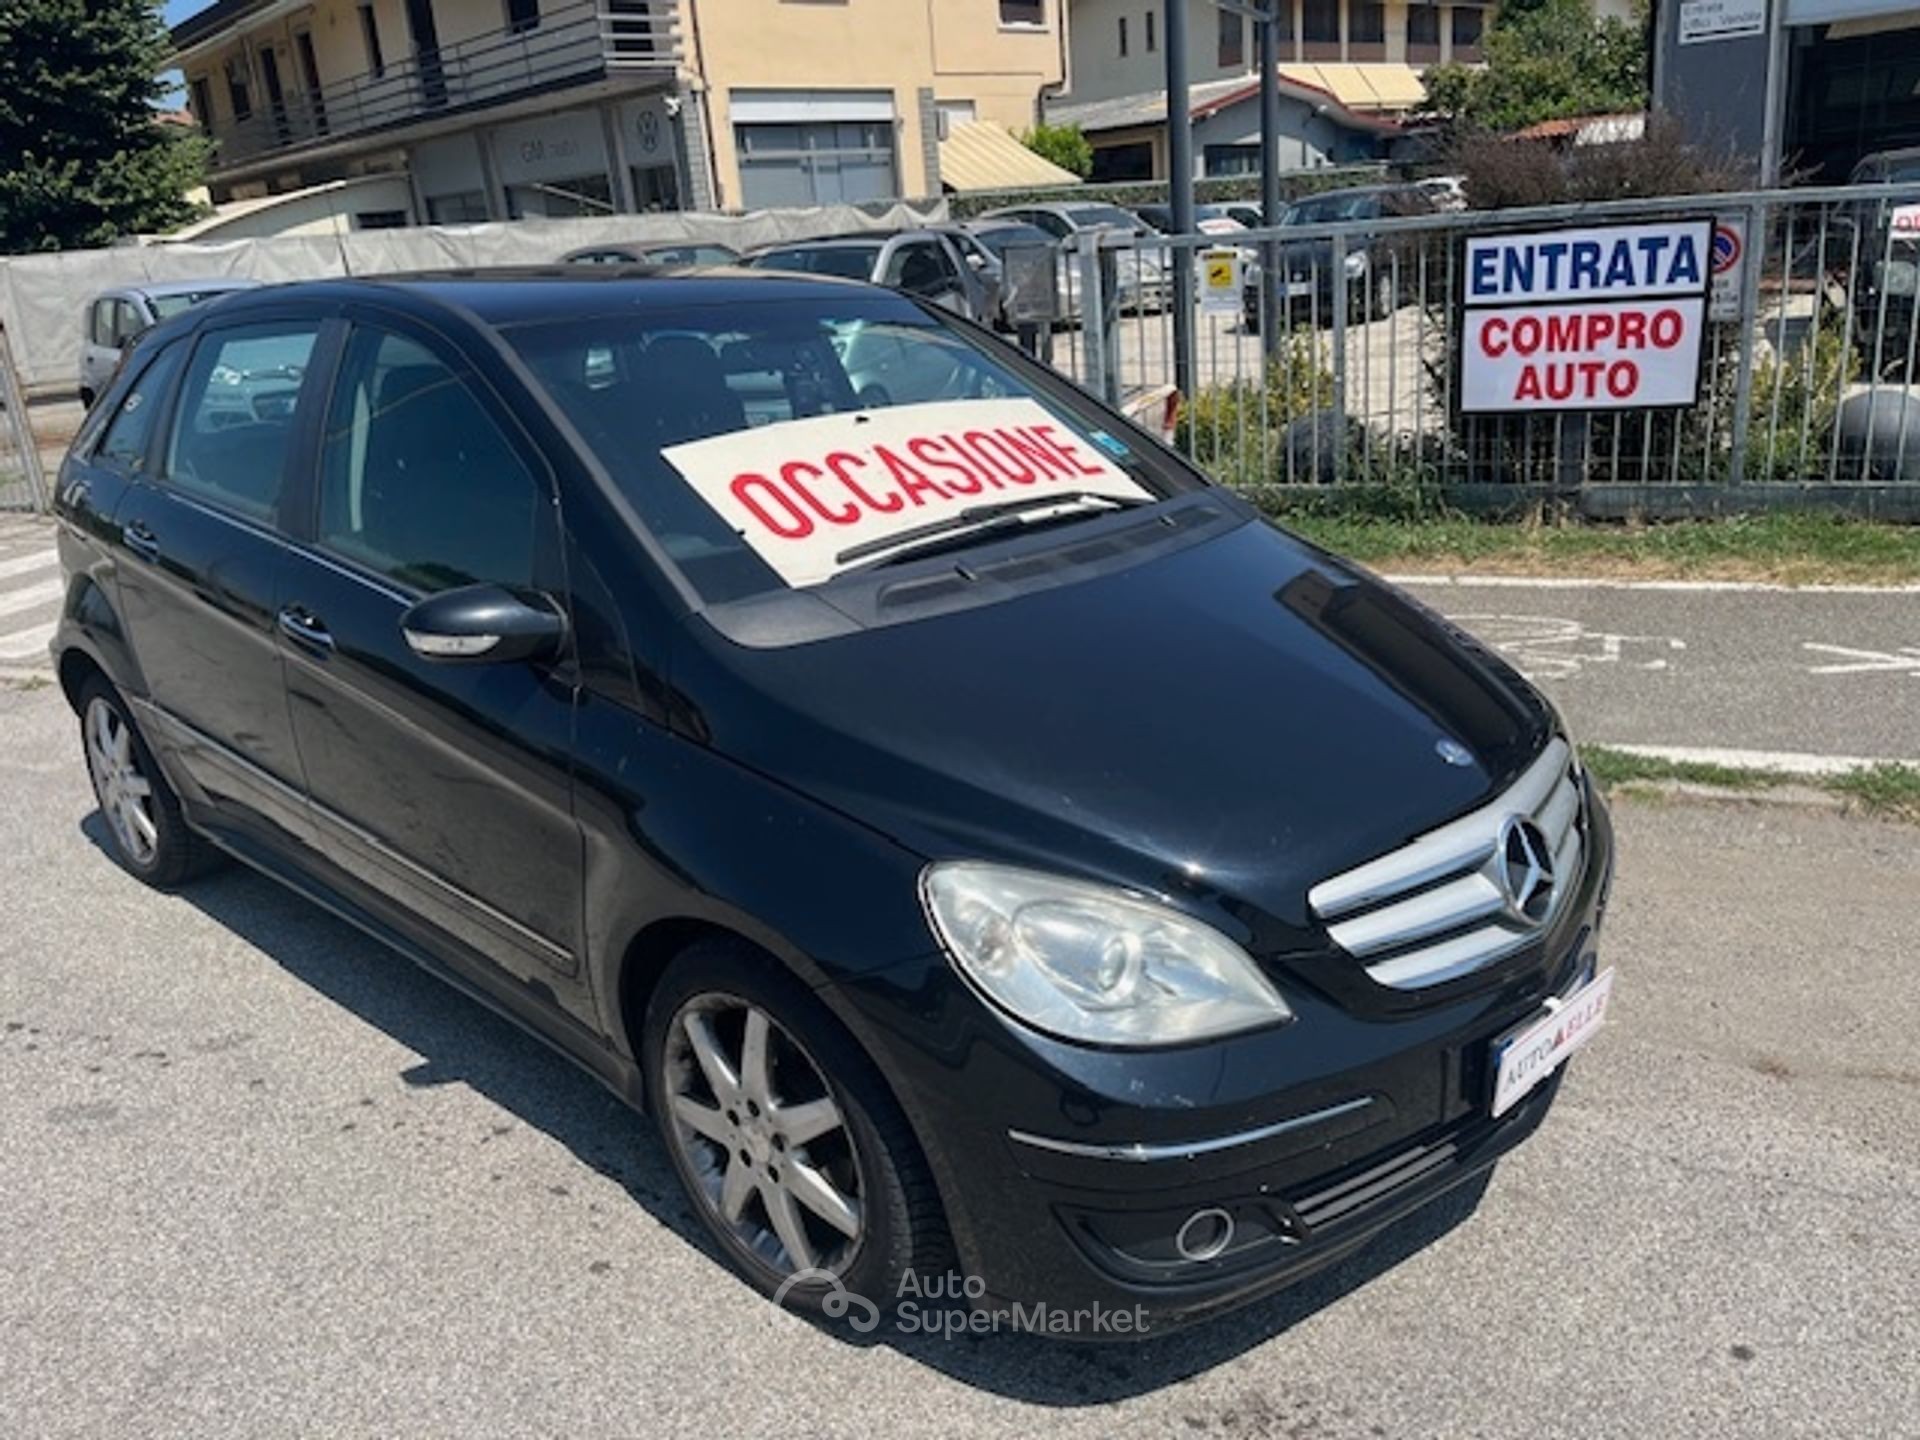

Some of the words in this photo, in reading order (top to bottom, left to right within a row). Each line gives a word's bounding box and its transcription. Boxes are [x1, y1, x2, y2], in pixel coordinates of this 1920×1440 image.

[1471, 235, 1699, 295] ENTRATA
[1480, 309, 1683, 358] COMPRO
[1514, 360, 1639, 401] AUTO
[729, 425, 1105, 540] OCCASIONE
